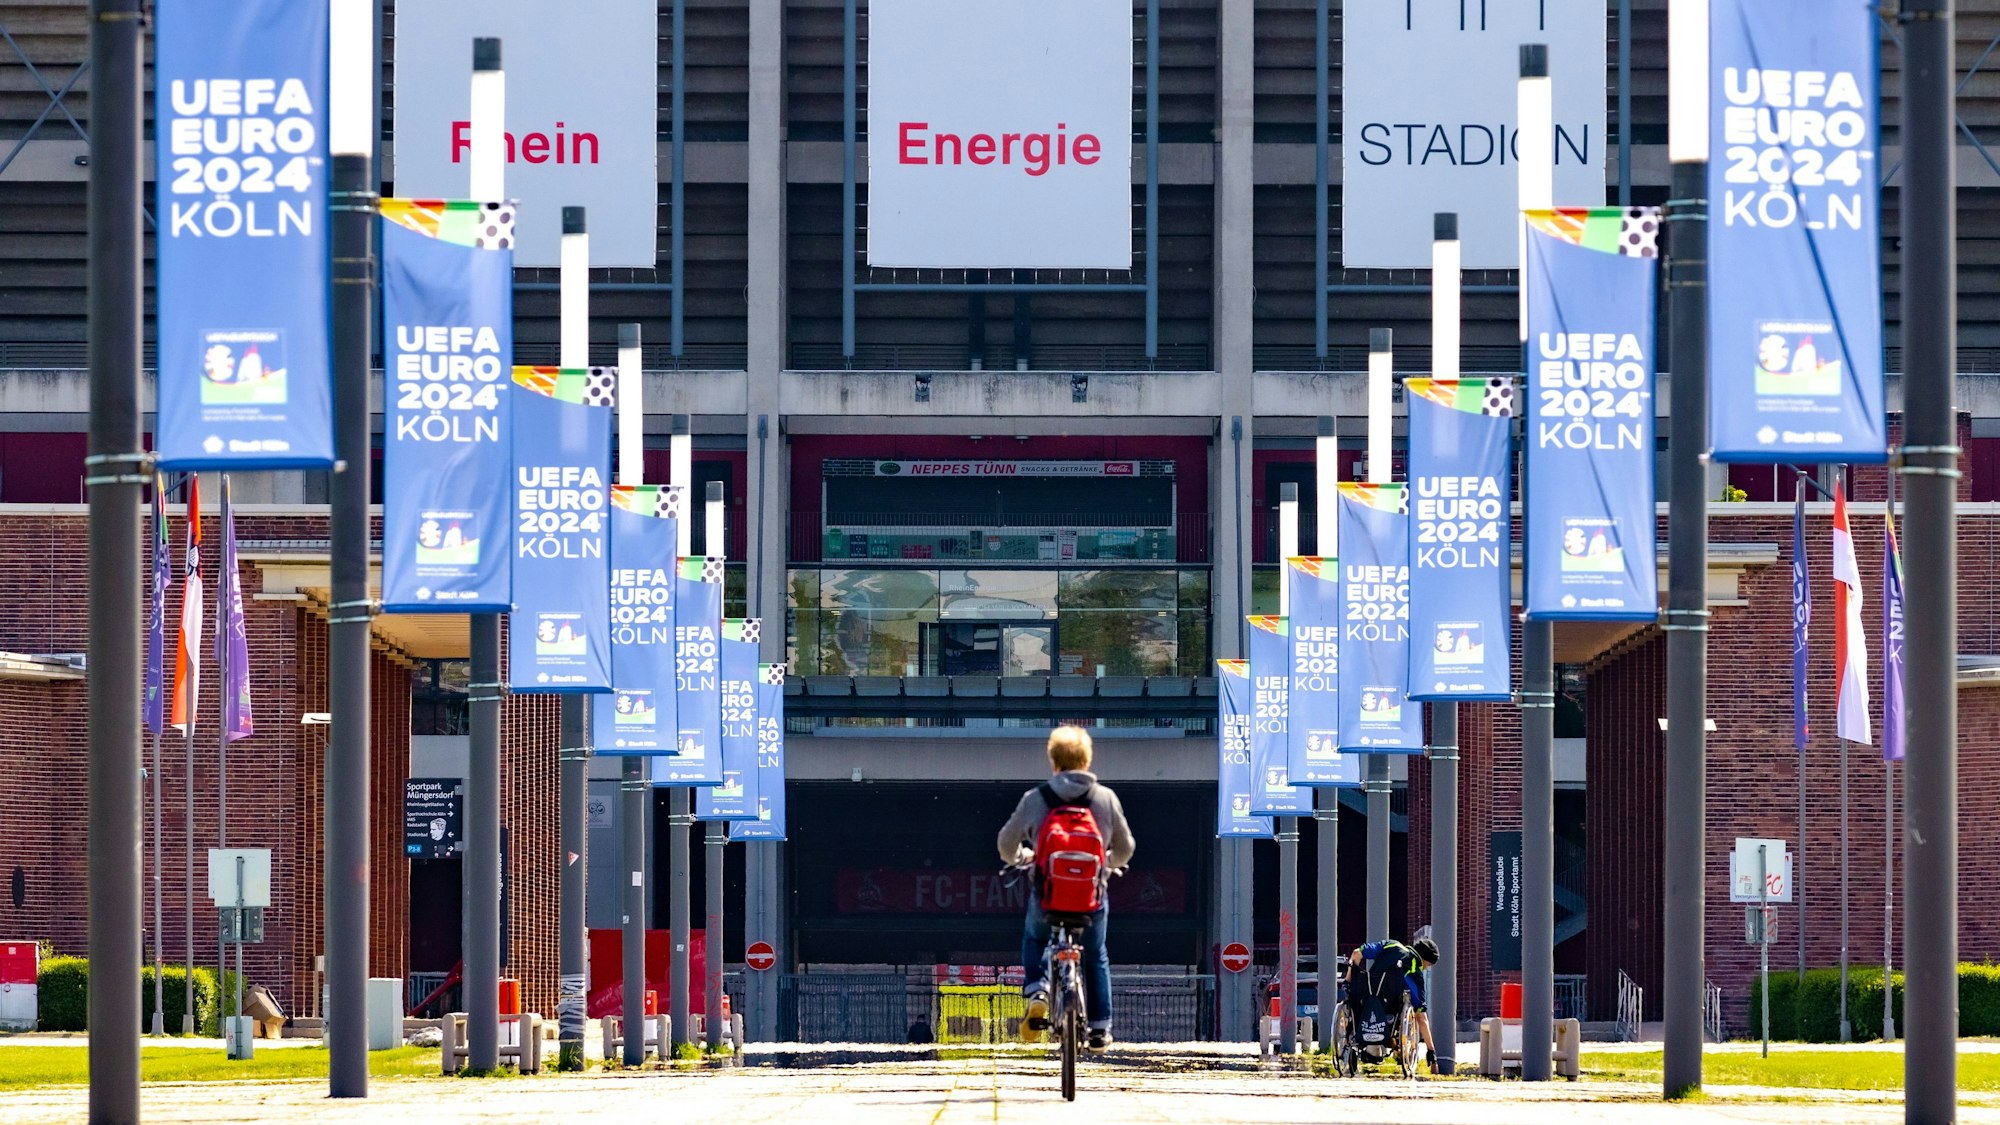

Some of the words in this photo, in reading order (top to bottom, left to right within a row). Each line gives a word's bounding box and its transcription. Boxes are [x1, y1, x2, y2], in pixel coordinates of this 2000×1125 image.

[172, 79, 313, 116] UEFA
[1723, 67, 1865, 109] UEFA
[172, 117, 315, 155] EURO
[1724, 106, 1866, 148] EURO
[898, 122, 1101, 177] Energie
[1359, 123, 1589, 166] STADIN
[172, 194, 312, 237] KÖLN
[1724, 183, 1861, 230] KÖLN
[397, 326, 500, 353] UEFA
[1540, 332, 1643, 361] UEFA
[398, 354, 501, 382] EURO
[1540, 362, 1644, 389] EURO
[398, 411, 498, 442] KÖLN
[1540, 418, 1642, 449] KÖLN
[519, 467, 602, 488] UEFA
[911, 464, 970, 475] NEPPES
[974, 461, 1017, 475] TÜNN
[1060, 464, 1098, 473] GETRÄNKE
[1418, 477, 1500, 497] UEFA
[519, 489, 604, 510] EURO
[1418, 499, 1501, 520] EURO
[519, 534, 601, 559] KÖLN
[1418, 543, 1498, 568] KÖLN
[1347, 565, 1408, 583] UEFA
[1347, 583, 1409, 602] EURO
[1347, 602, 1408, 620] 2024
[1295, 625, 1337, 641] UEF
[1346, 620, 1408, 642] KÖLN
[1295, 641, 1338, 657] EUR
[1295, 657, 1337, 673] 202
[1294, 673, 1337, 693] KÖL
[759, 717, 778, 729] FA
[759, 730, 779, 741] RO
[759, 742, 778, 753] 24
[759, 756, 778, 767] LN
[407, 783, 442, 791] Sportpark
[407, 791, 454, 800] Müngersdorf
[1496, 856, 1506, 911] Westgebäude
[1511, 856, 1520, 894] Sportamt
[1511, 895, 1519, 913] Köln
[1511, 915, 1519, 937] Stadt
